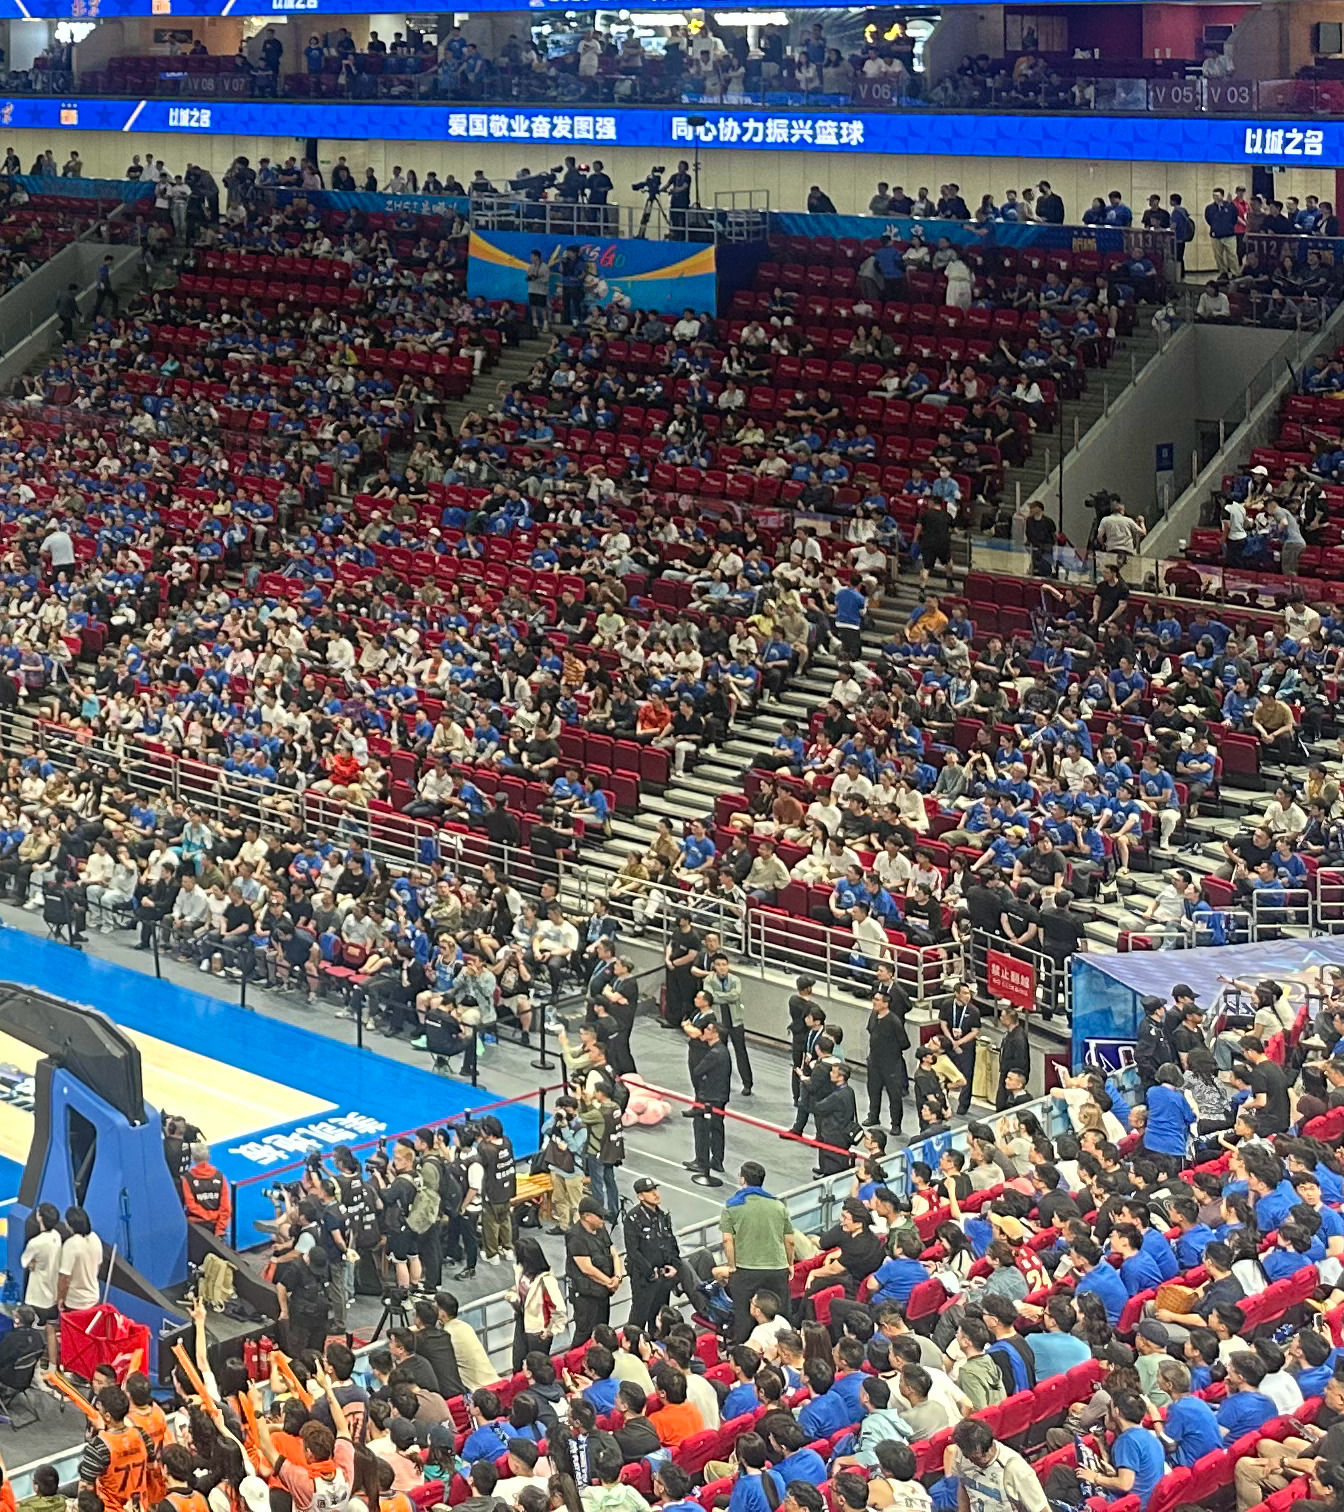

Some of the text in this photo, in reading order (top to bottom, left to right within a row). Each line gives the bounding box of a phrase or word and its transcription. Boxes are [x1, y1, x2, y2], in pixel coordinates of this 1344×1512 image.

[1156, 87, 1193, 104] V 05
[1212, 88, 1249, 104] V 03
[169, 107, 211, 128] 以城之名
[448, 113, 617, 140] 爱国敬业奋发图强
[1245, 128, 1323, 156] 以城之名
[113, 1462, 145, 1494] 77
